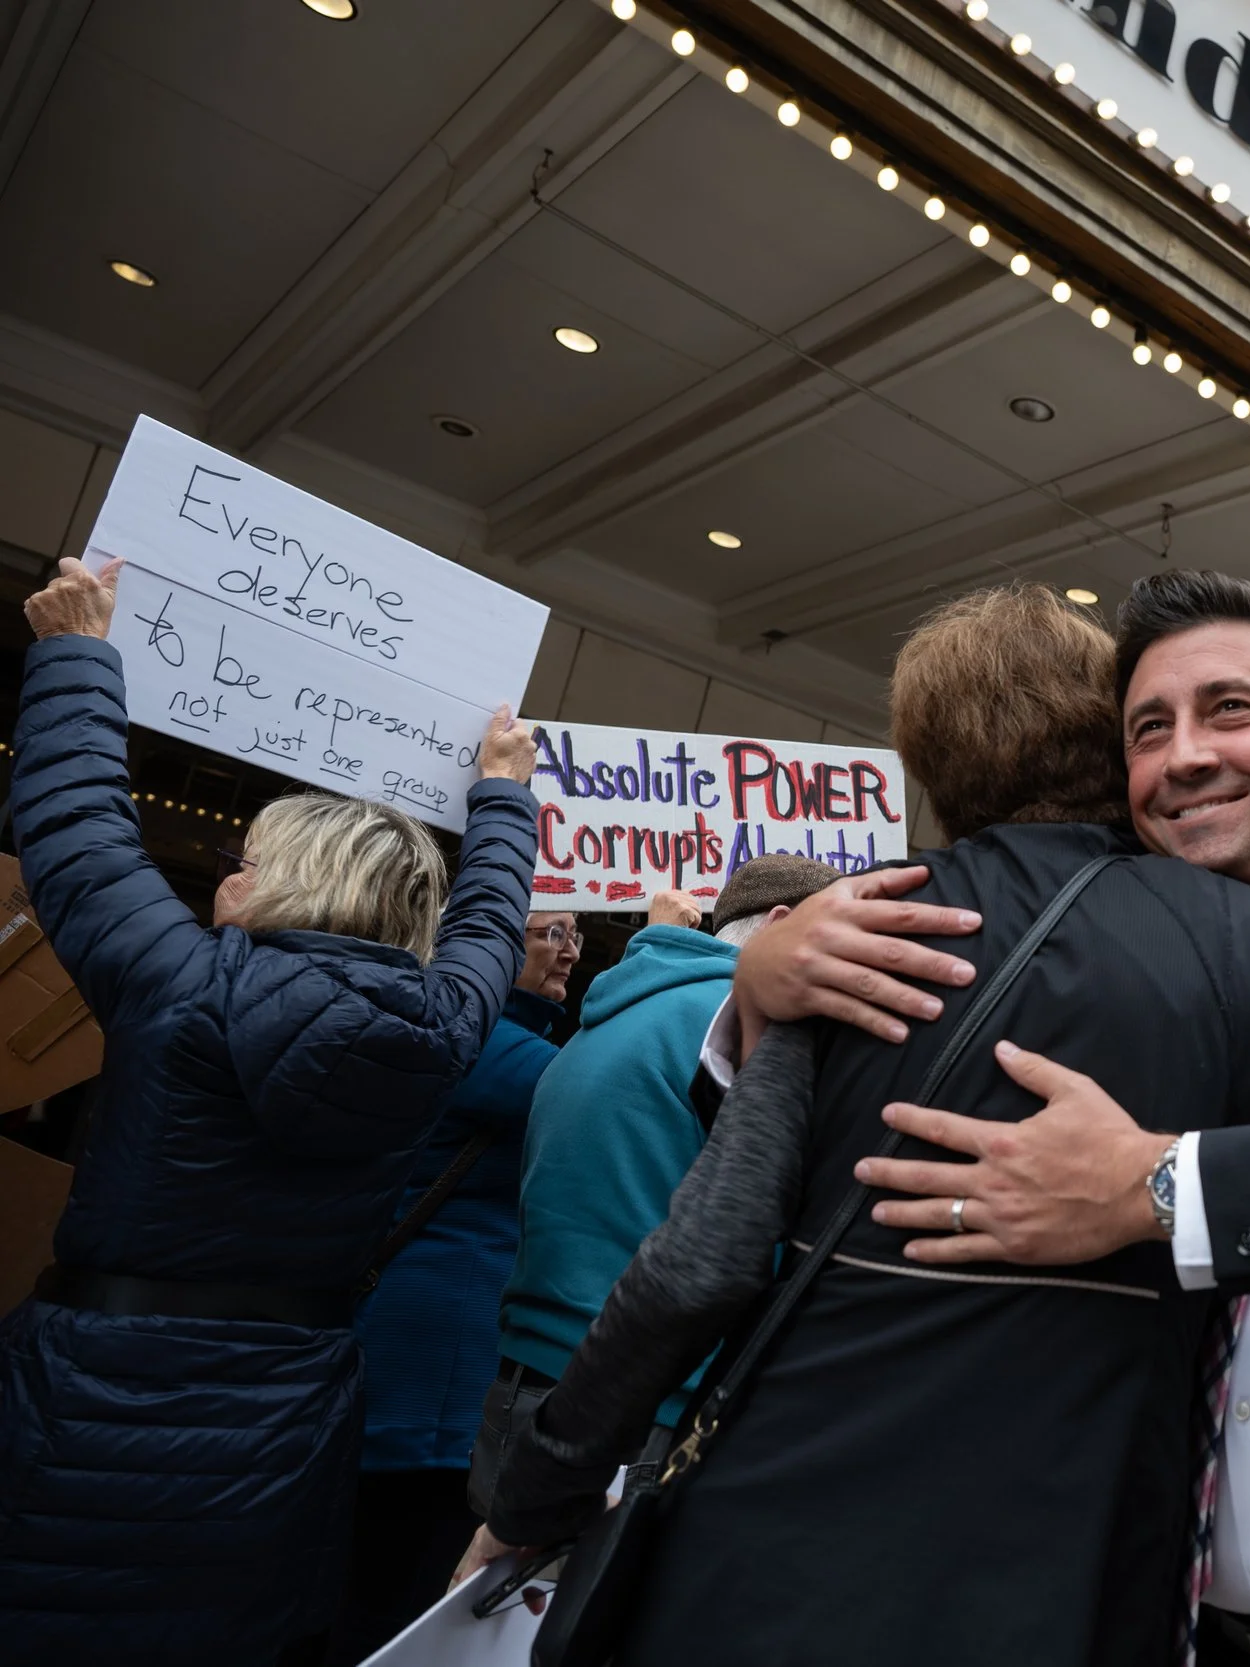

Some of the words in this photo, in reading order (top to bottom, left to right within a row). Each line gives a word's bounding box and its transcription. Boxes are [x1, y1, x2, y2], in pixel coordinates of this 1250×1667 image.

[179, 464, 414, 622] Everyone
[217, 565, 404, 660] deserves
[134, 592, 184, 667] to
[214, 624, 272, 700] be
[294, 686, 481, 768] represented
[168, 690, 227, 723] not
[237, 720, 308, 753] just
[322, 748, 364, 776] one
[383, 770, 449, 808] group
[531, 725, 720, 809] Absolute
[722, 739, 901, 823] POWER
[538, 802, 724, 890] Corrupts
